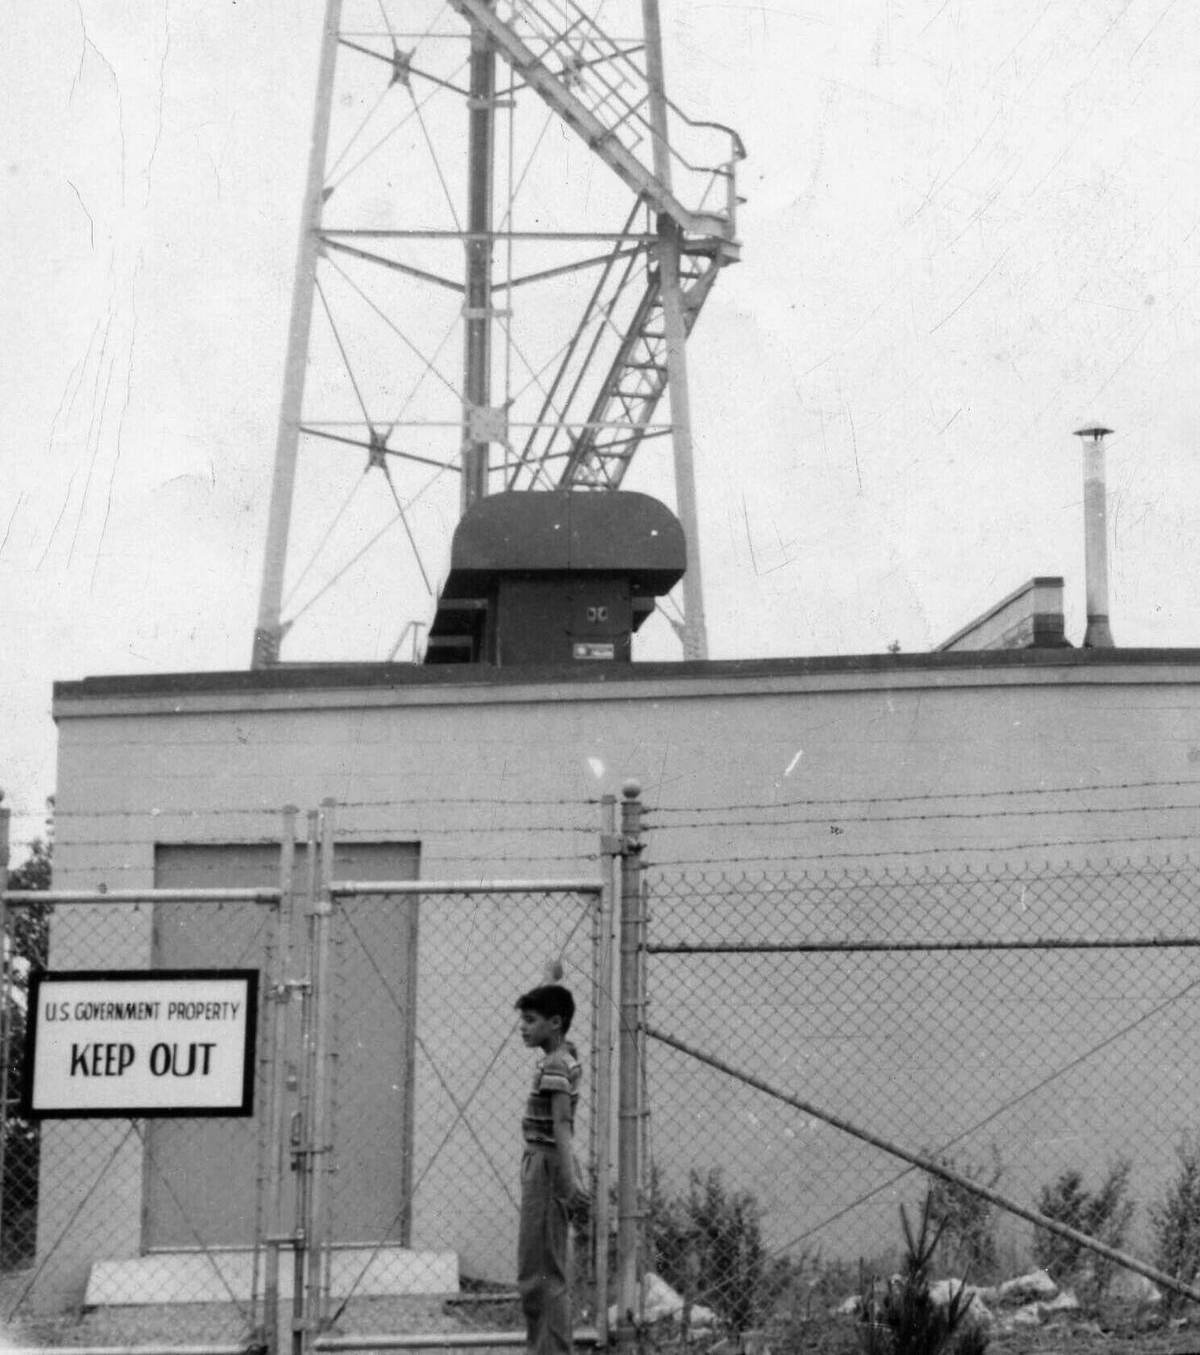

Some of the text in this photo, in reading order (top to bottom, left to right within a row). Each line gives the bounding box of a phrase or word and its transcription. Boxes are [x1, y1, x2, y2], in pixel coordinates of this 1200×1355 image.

[74, 1001, 161, 1021] GOVERNMENT
[167, 1001, 240, 1020] PROPERTY
[70, 1042, 217, 1077] KEEP OUT
